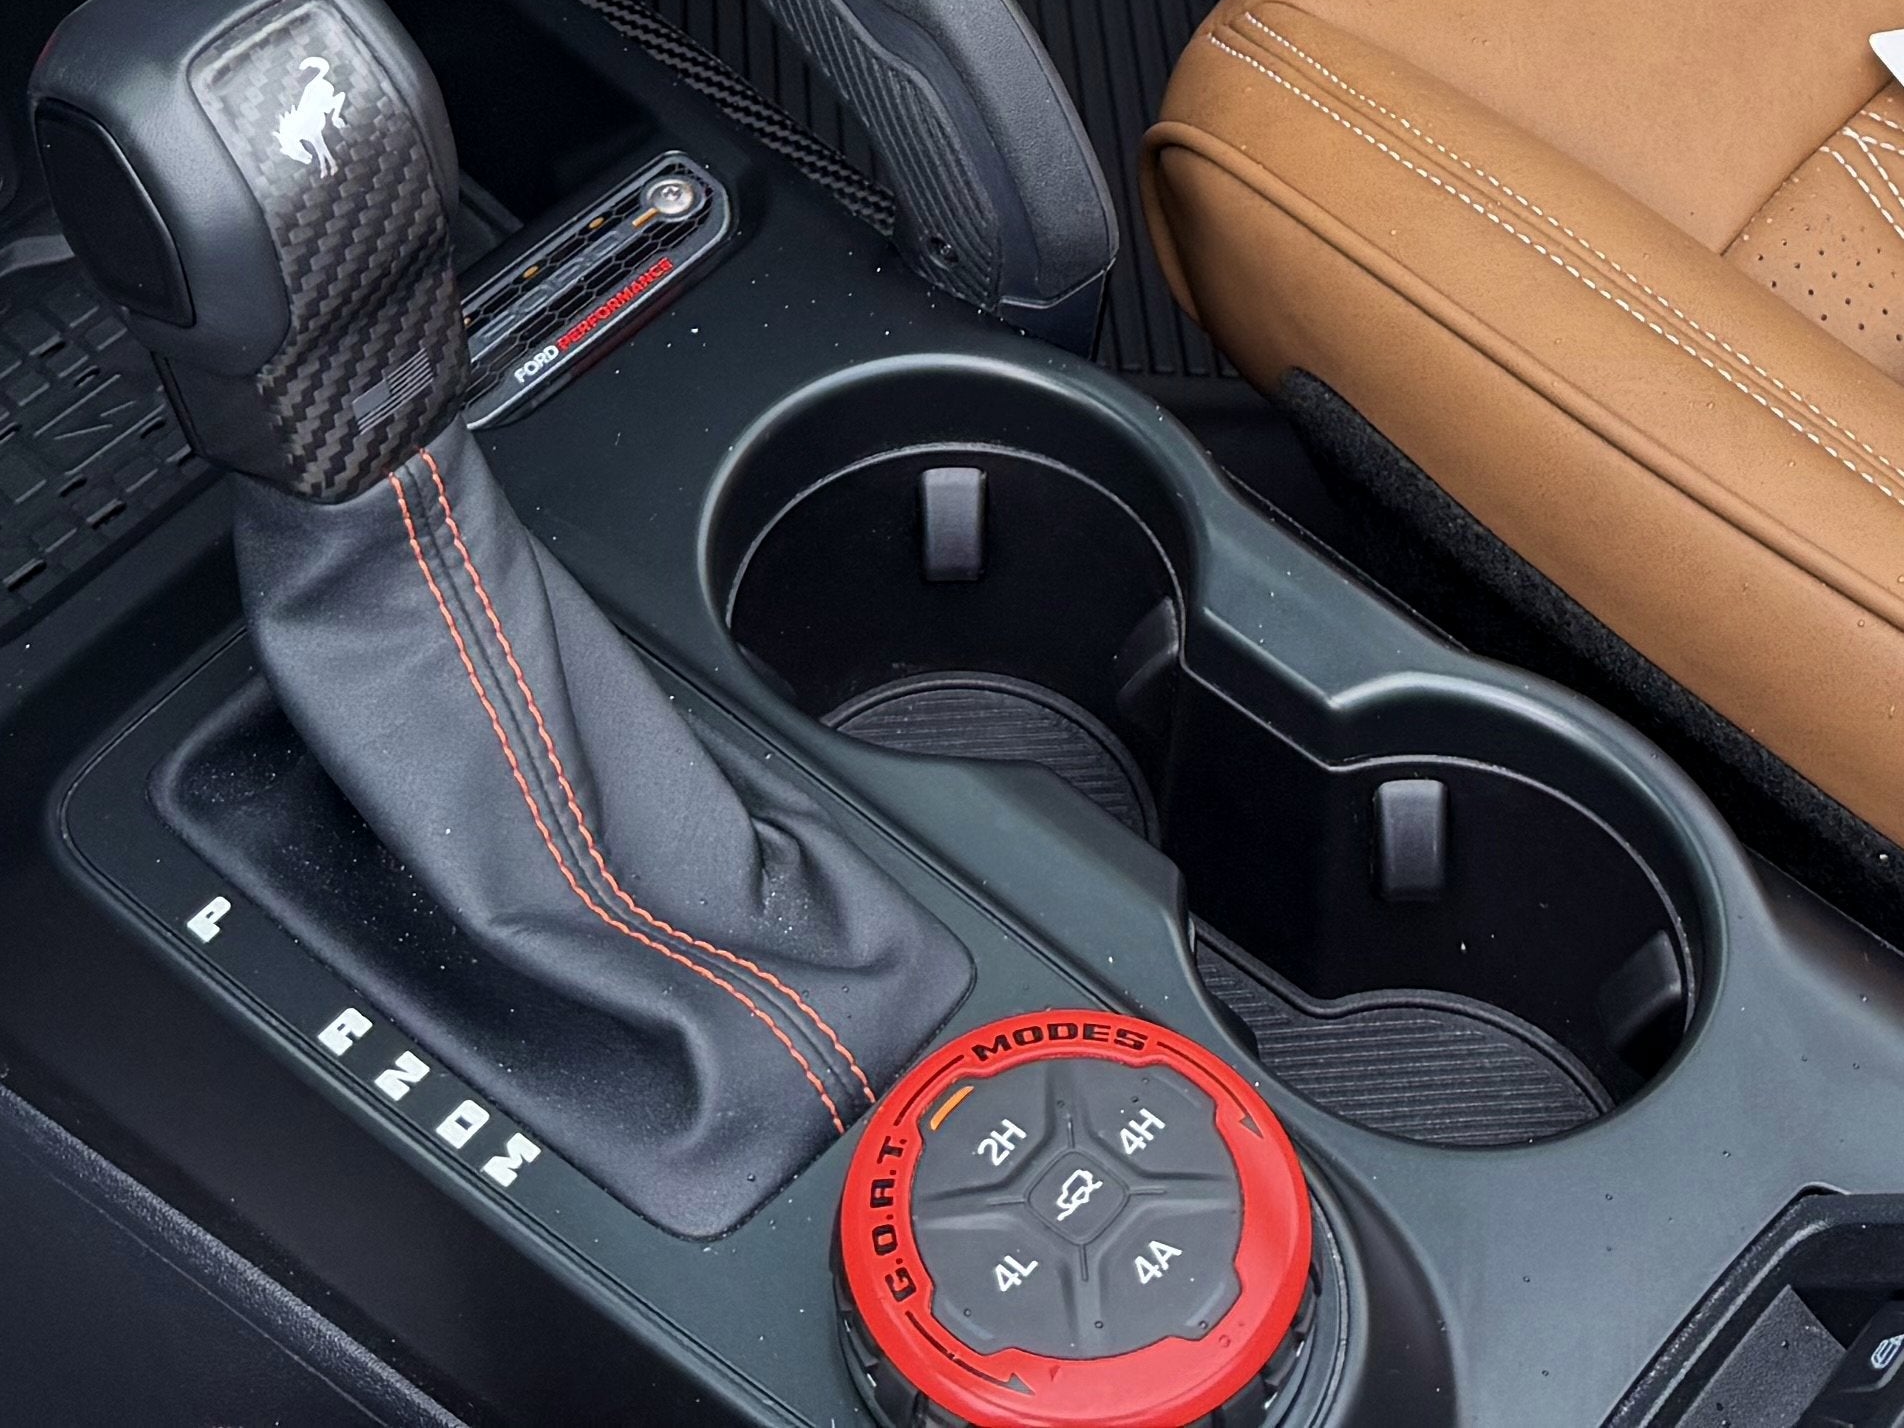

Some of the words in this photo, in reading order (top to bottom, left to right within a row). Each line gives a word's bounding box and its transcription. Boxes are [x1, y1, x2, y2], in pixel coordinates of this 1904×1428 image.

[514, 345, 559, 383] FORD
[557, 257, 673, 351] PERFORMANCE
[187, 896, 231, 942] P
[318, 1008, 373, 1056] R
[969, 1022, 1149, 1062] MODES
[374, 1050, 430, 1101] N
[436, 1100, 490, 1148] D
[977, 1118, 1027, 1167] 2H
[1118, 1107, 1166, 1156] 4H
[482, 1132, 541, 1187] M
[994, 1254, 1038, 1293] 4L
[1132, 1240, 1182, 1286] 4A
